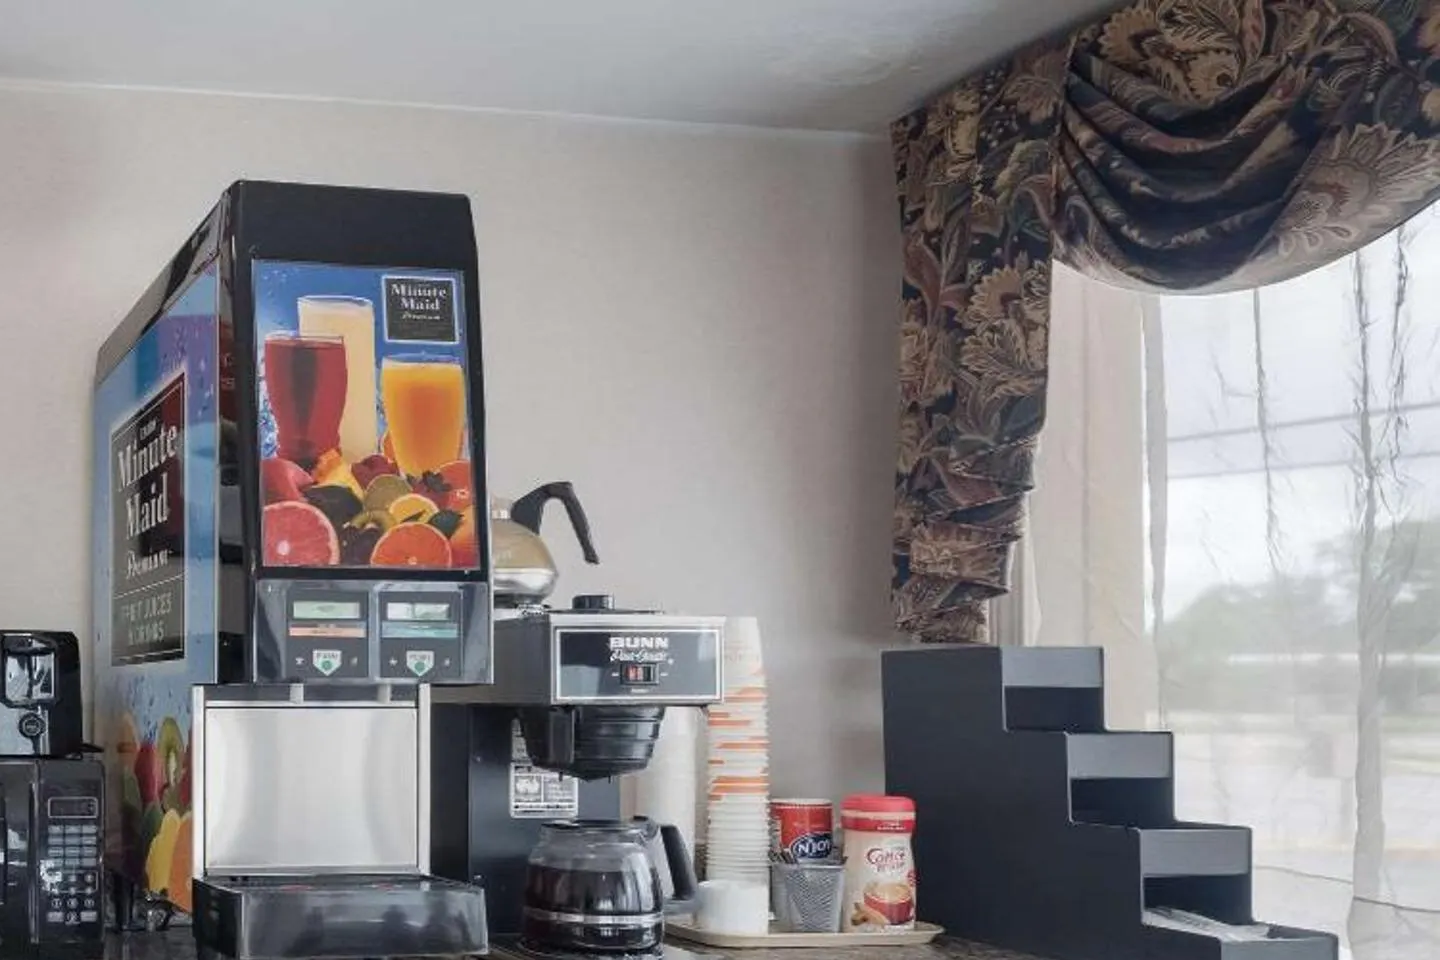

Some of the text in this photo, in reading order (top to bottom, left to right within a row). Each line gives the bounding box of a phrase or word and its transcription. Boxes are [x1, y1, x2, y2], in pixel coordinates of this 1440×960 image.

[391, 283, 447, 298] Minute
[401, 297, 440, 310] Maid
[117, 424, 177, 492] Minute
[126, 472, 169, 540] Maid
[609, 636, 669, 650] BUNN
